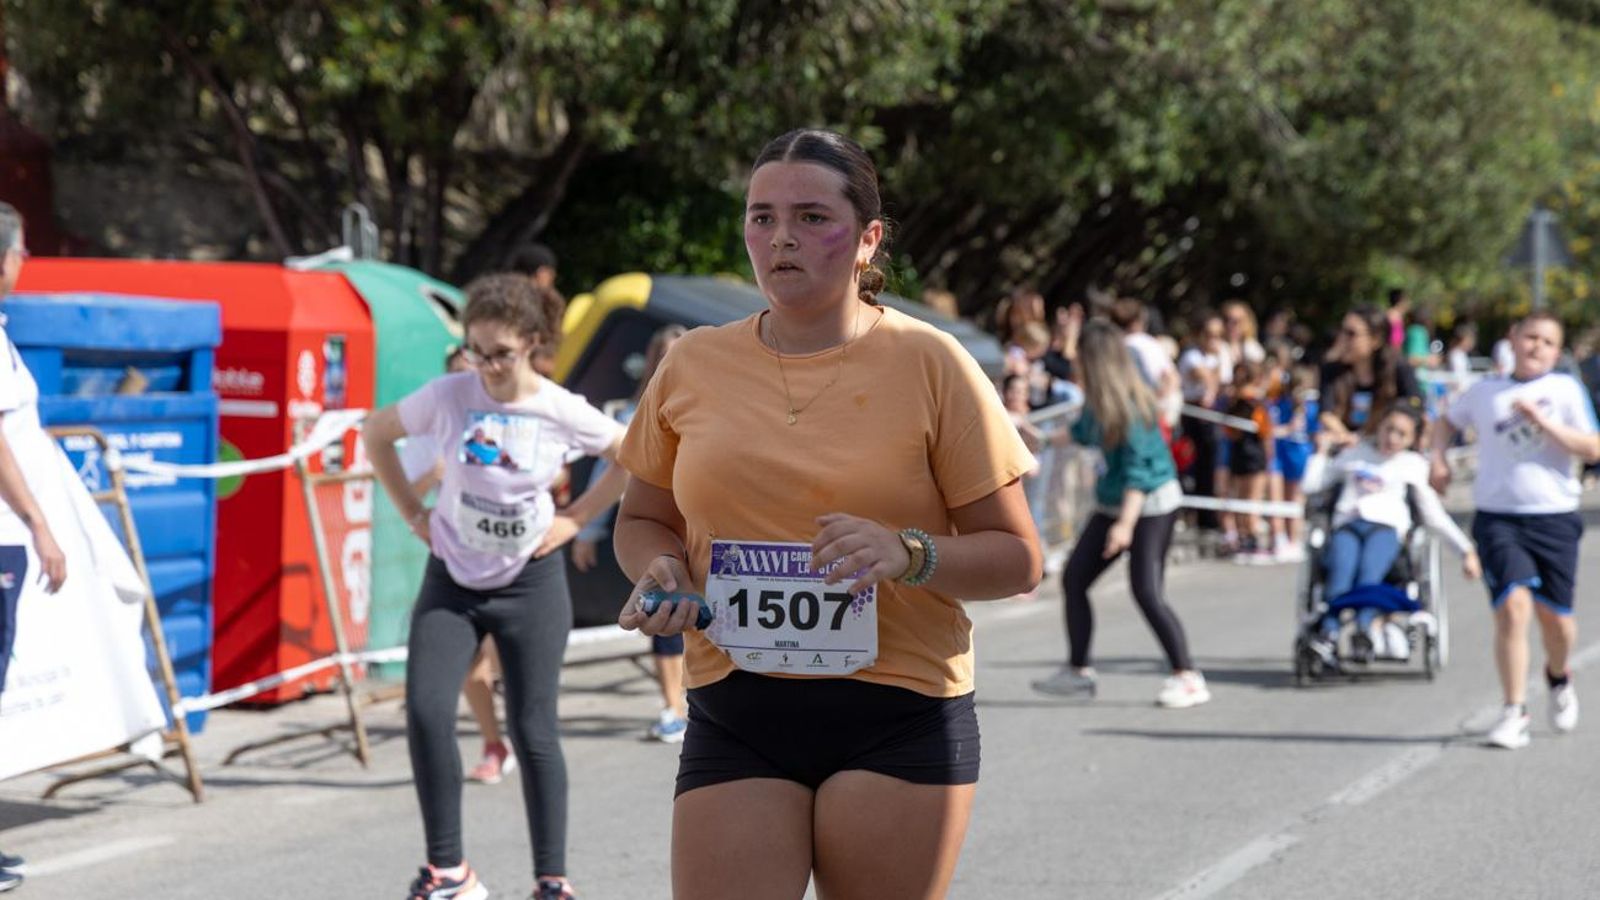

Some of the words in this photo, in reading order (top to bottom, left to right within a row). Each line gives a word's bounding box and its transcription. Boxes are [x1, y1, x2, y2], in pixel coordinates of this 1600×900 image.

[477, 518, 526, 538] 466
[737, 549, 788, 573] XXXVI
[729, 589, 853, 631] 1507
[774, 640, 800, 648] MARTINA
